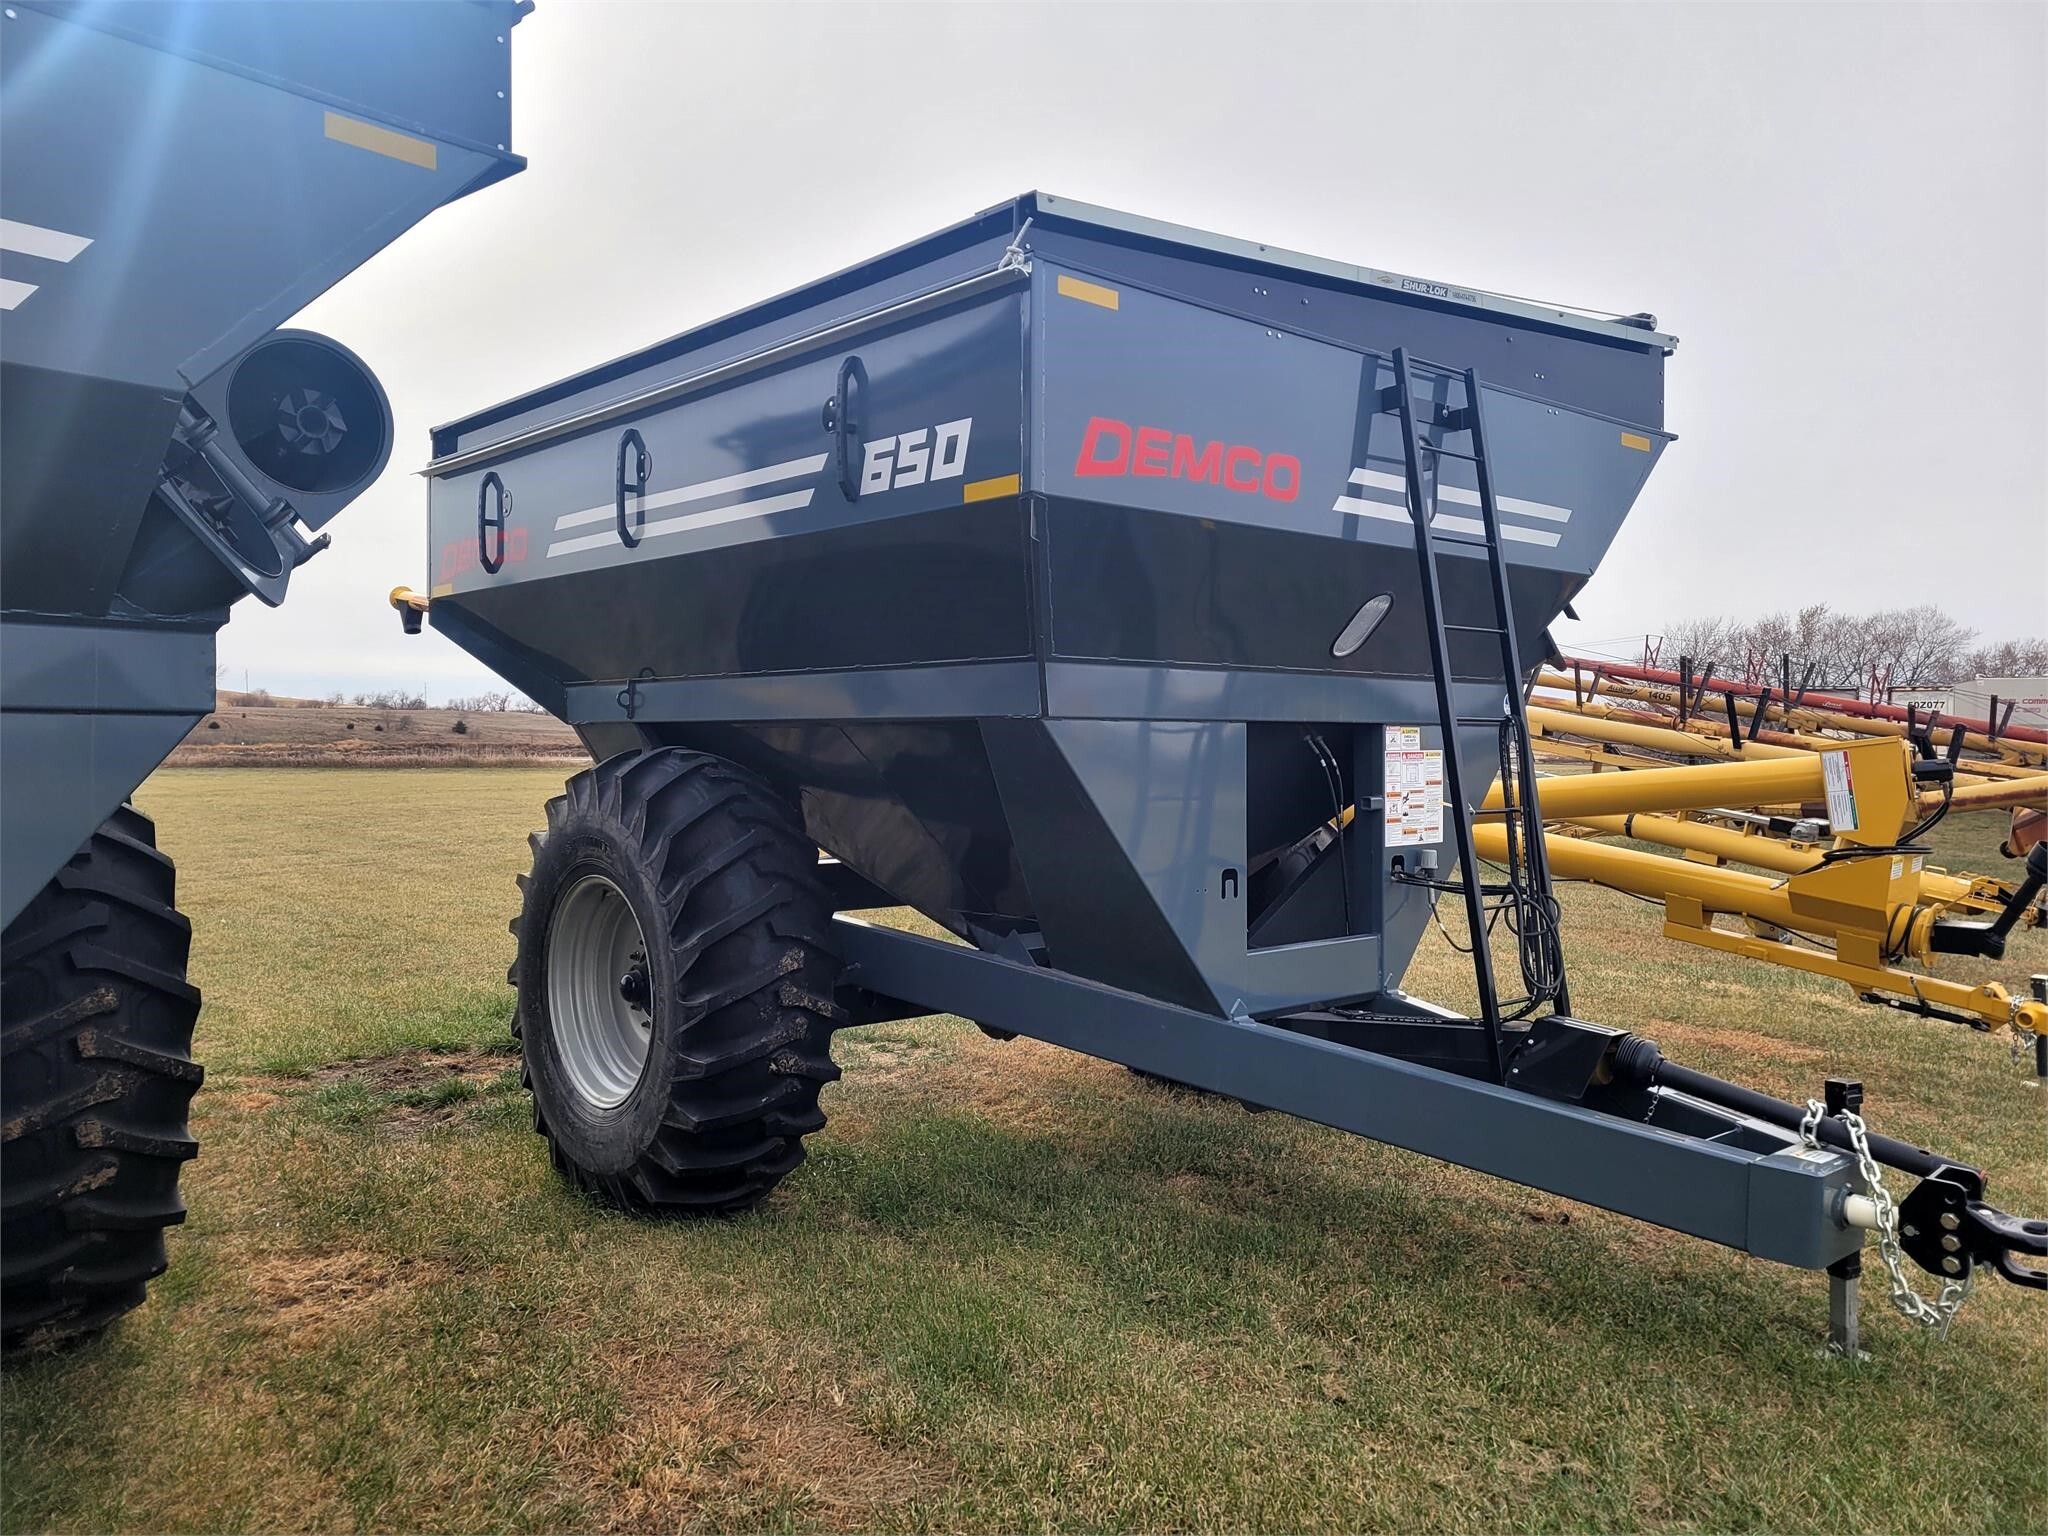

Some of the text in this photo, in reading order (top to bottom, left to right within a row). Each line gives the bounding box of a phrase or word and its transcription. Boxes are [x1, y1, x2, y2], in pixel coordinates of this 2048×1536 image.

[860, 417, 973, 496] 650
[1074, 416, 1301, 504] DEMCO
[1648, 691, 1672, 702] 1405
